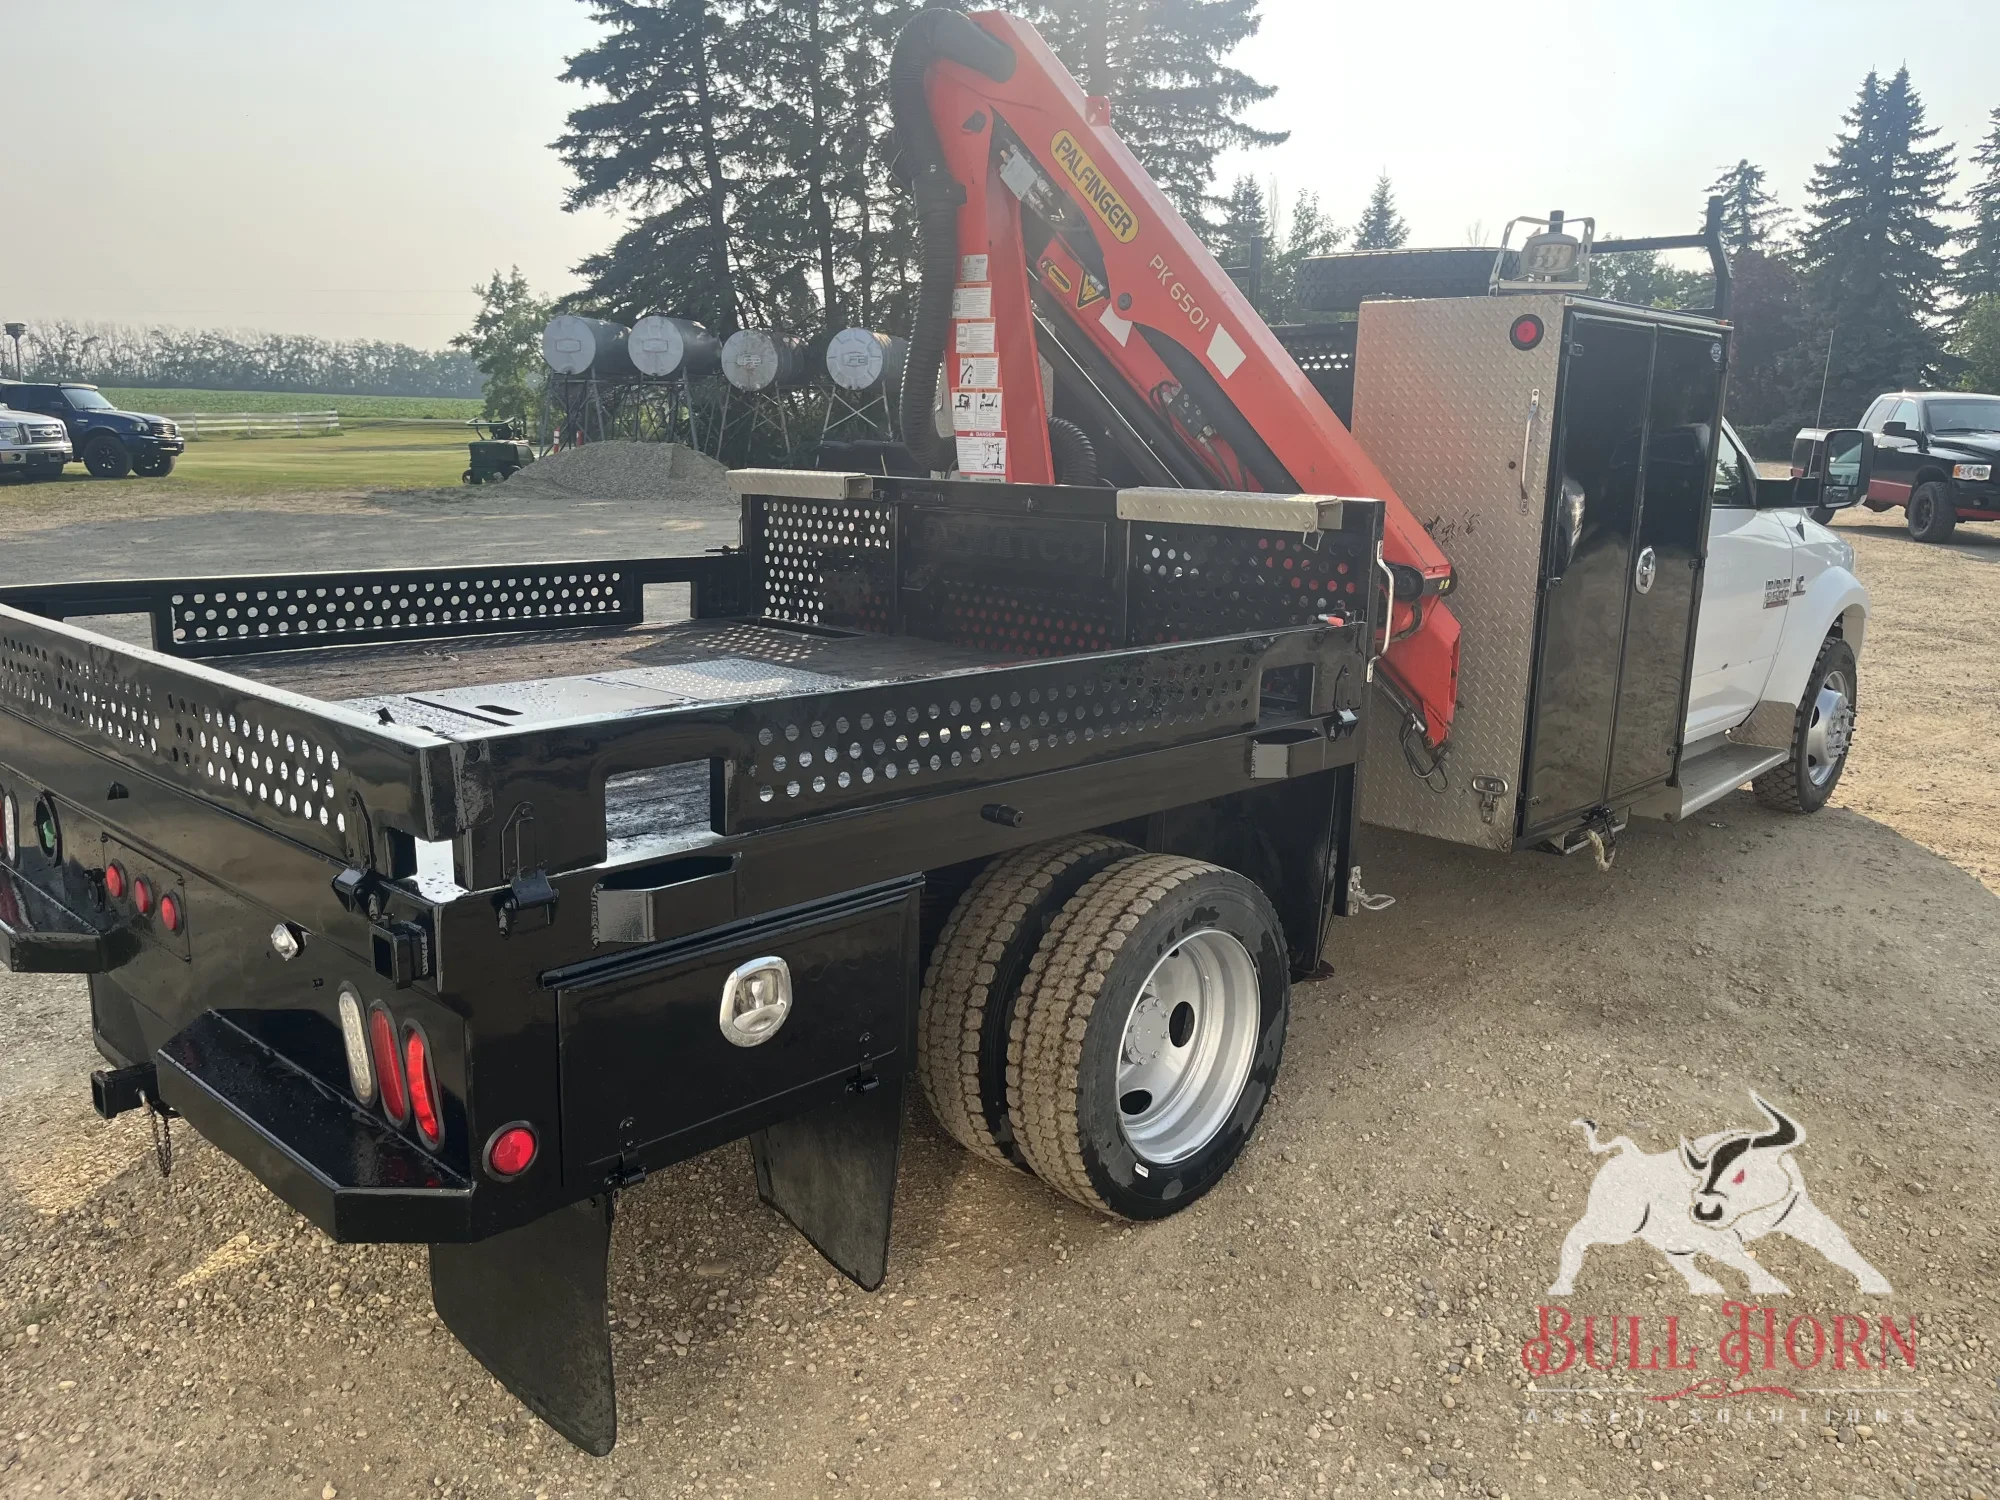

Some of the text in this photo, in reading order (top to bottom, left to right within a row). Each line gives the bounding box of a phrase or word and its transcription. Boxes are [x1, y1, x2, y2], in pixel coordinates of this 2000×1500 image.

[1055, 135, 1133, 237] PALFINGER
[1149, 253, 1210, 333] PK 6501
